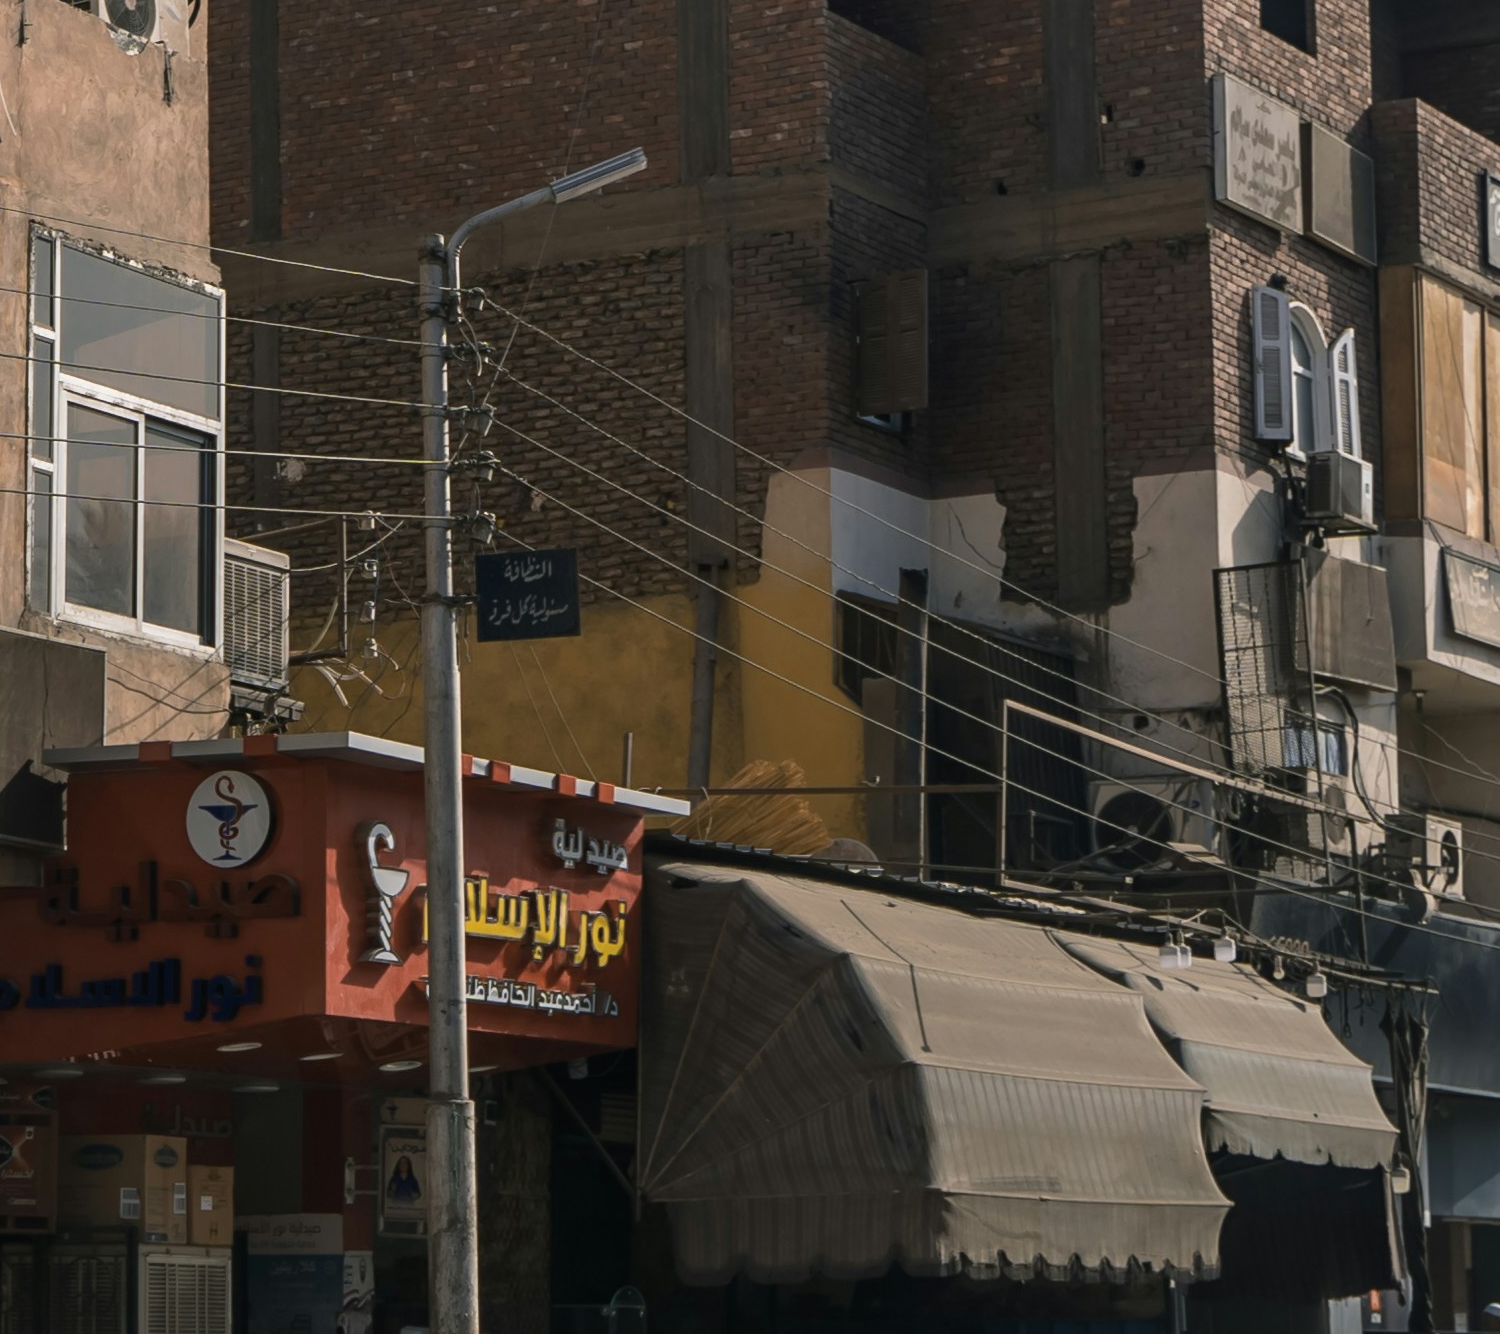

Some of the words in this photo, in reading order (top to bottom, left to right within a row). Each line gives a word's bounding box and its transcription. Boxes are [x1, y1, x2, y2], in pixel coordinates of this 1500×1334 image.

[422, 874, 570, 963] الإسلا
[572, 898, 629, 969] نور
[182, 953, 265, 1023] نور
